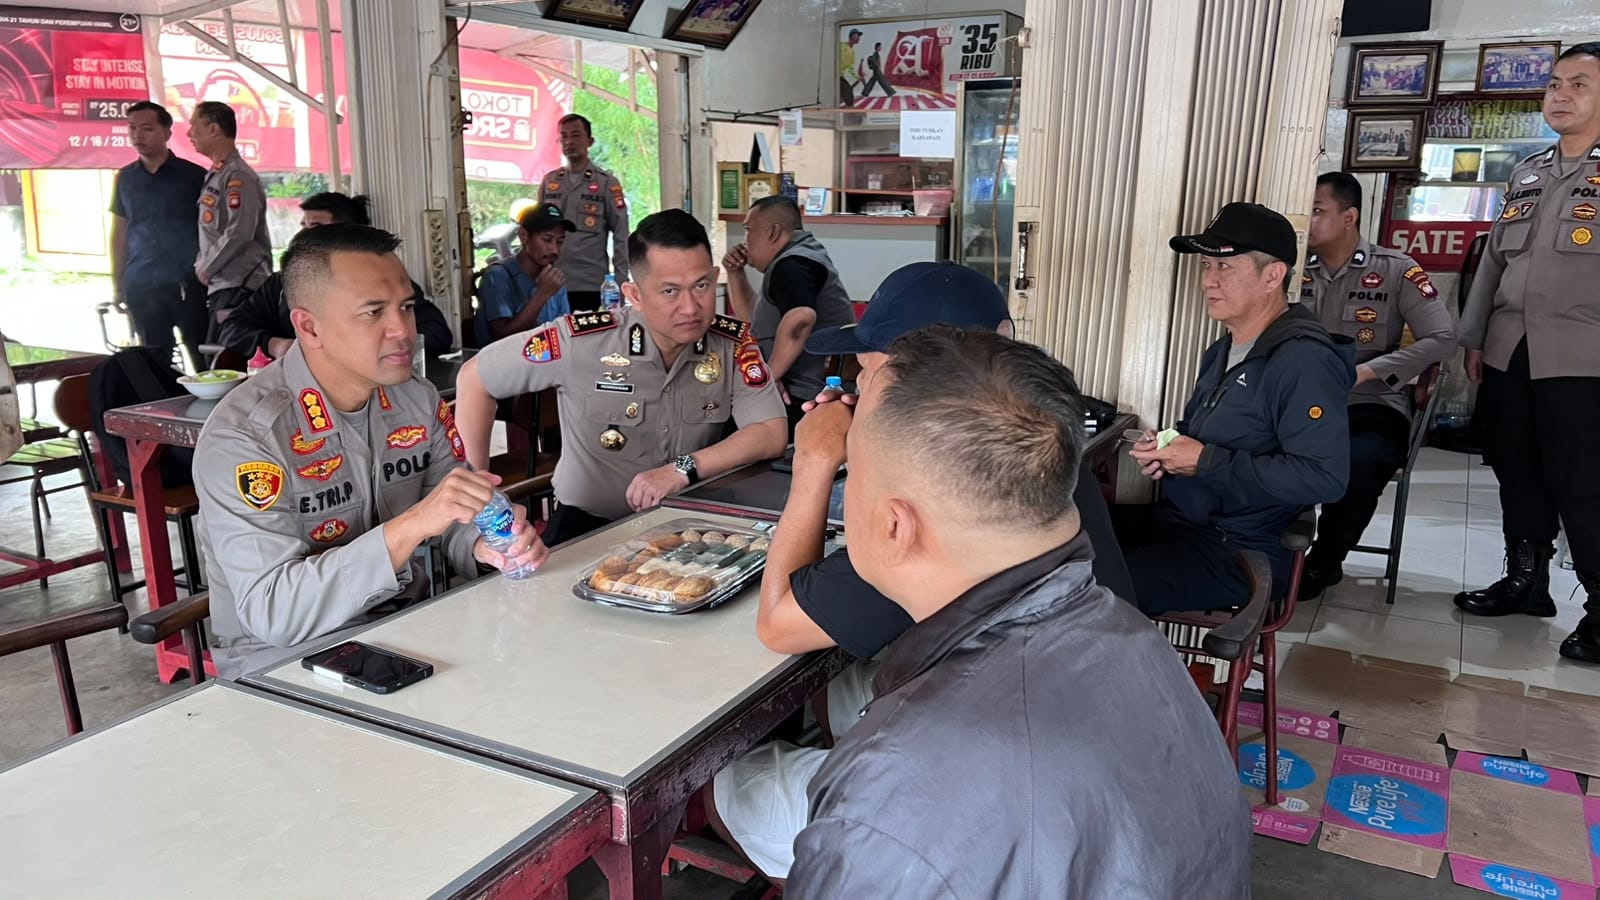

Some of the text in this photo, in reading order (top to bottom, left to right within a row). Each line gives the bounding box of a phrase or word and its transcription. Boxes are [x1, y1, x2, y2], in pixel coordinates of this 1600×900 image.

[961, 23, 999, 54] 35
[72, 58, 145, 73] STAY INTENSE
[960, 54, 993, 70] RIBU
[65, 75, 91, 89] STAY
[92, 76, 105, 89] IN
[69, 136, 81, 147] 12
[111, 136, 125, 147] 20
[1570, 187, 1600, 198] POL
[1392, 229, 1465, 254] SATE
[1348, 291, 1388, 302] POLRI
[1483, 761, 1545, 779] Pure Life
[1367, 779, 1409, 830] Pure Life
[1485, 872, 1557, 896] Pure Life
